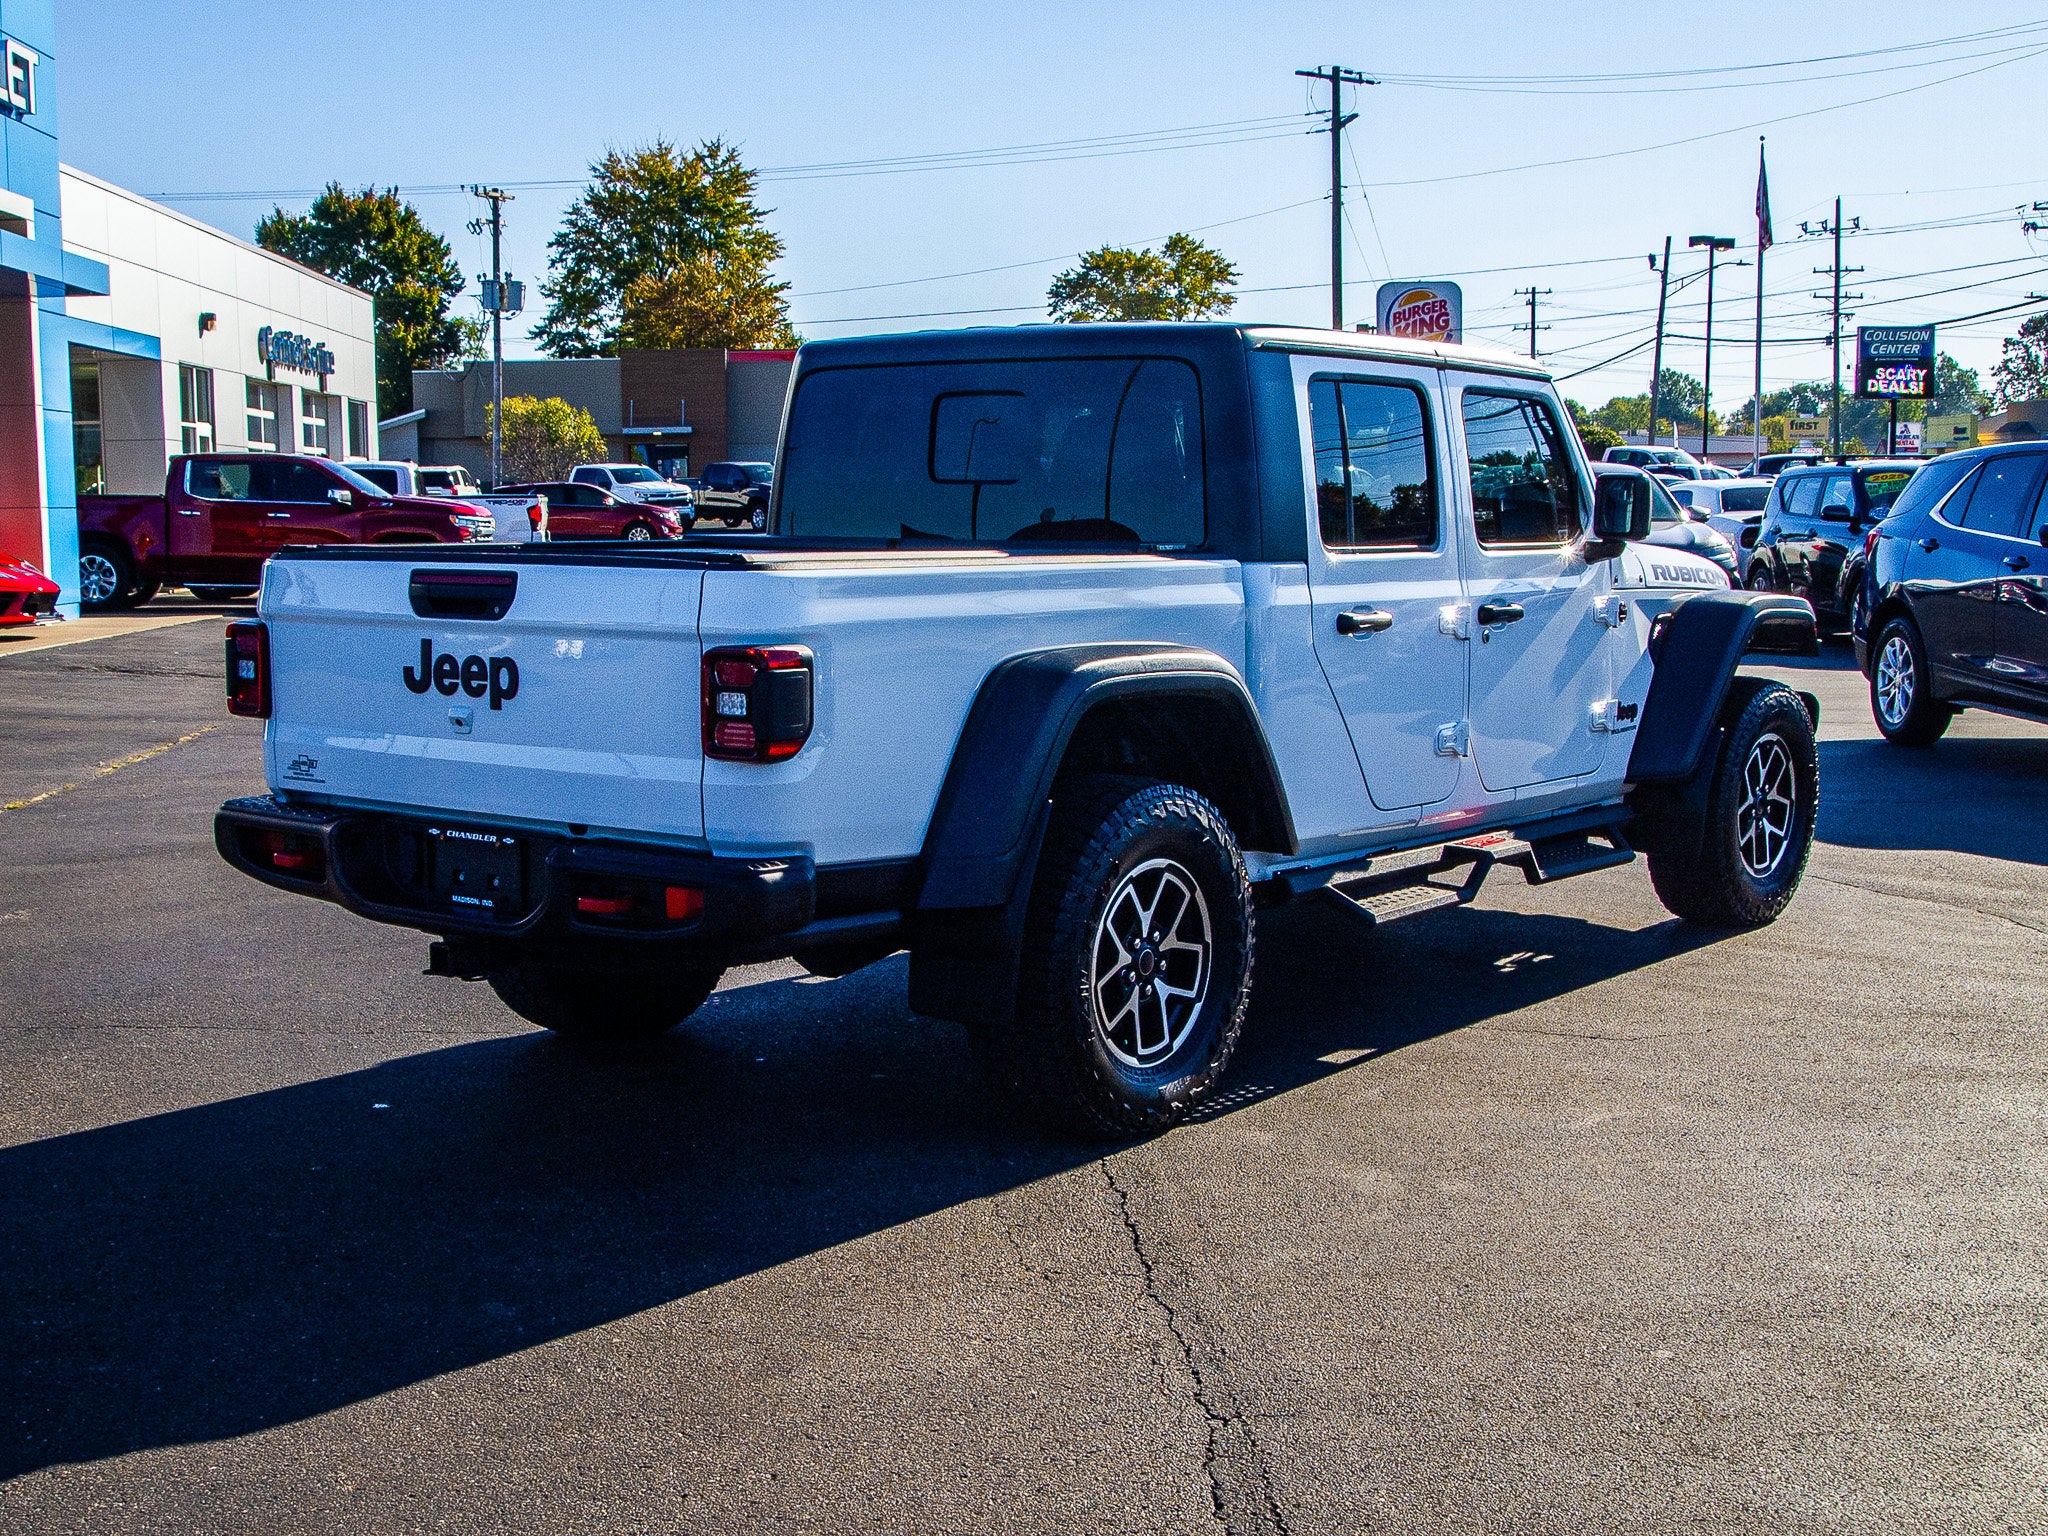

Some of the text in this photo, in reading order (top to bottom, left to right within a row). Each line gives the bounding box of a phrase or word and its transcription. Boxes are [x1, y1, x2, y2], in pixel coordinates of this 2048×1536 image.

[1393, 299, 1447, 326] BURGER
[1395, 311, 1450, 339] KING
[1864, 329, 1930, 341] COLLISION
[1870, 343, 1920, 354] CENTER
[1875, 367, 1928, 381] SCARY
[1867, 379, 1926, 395] DEALS!
[1652, 564, 1729, 586] RUBICON
[403, 638, 519, 711] Jeep
[446, 830, 497, 842] CHANDLER
